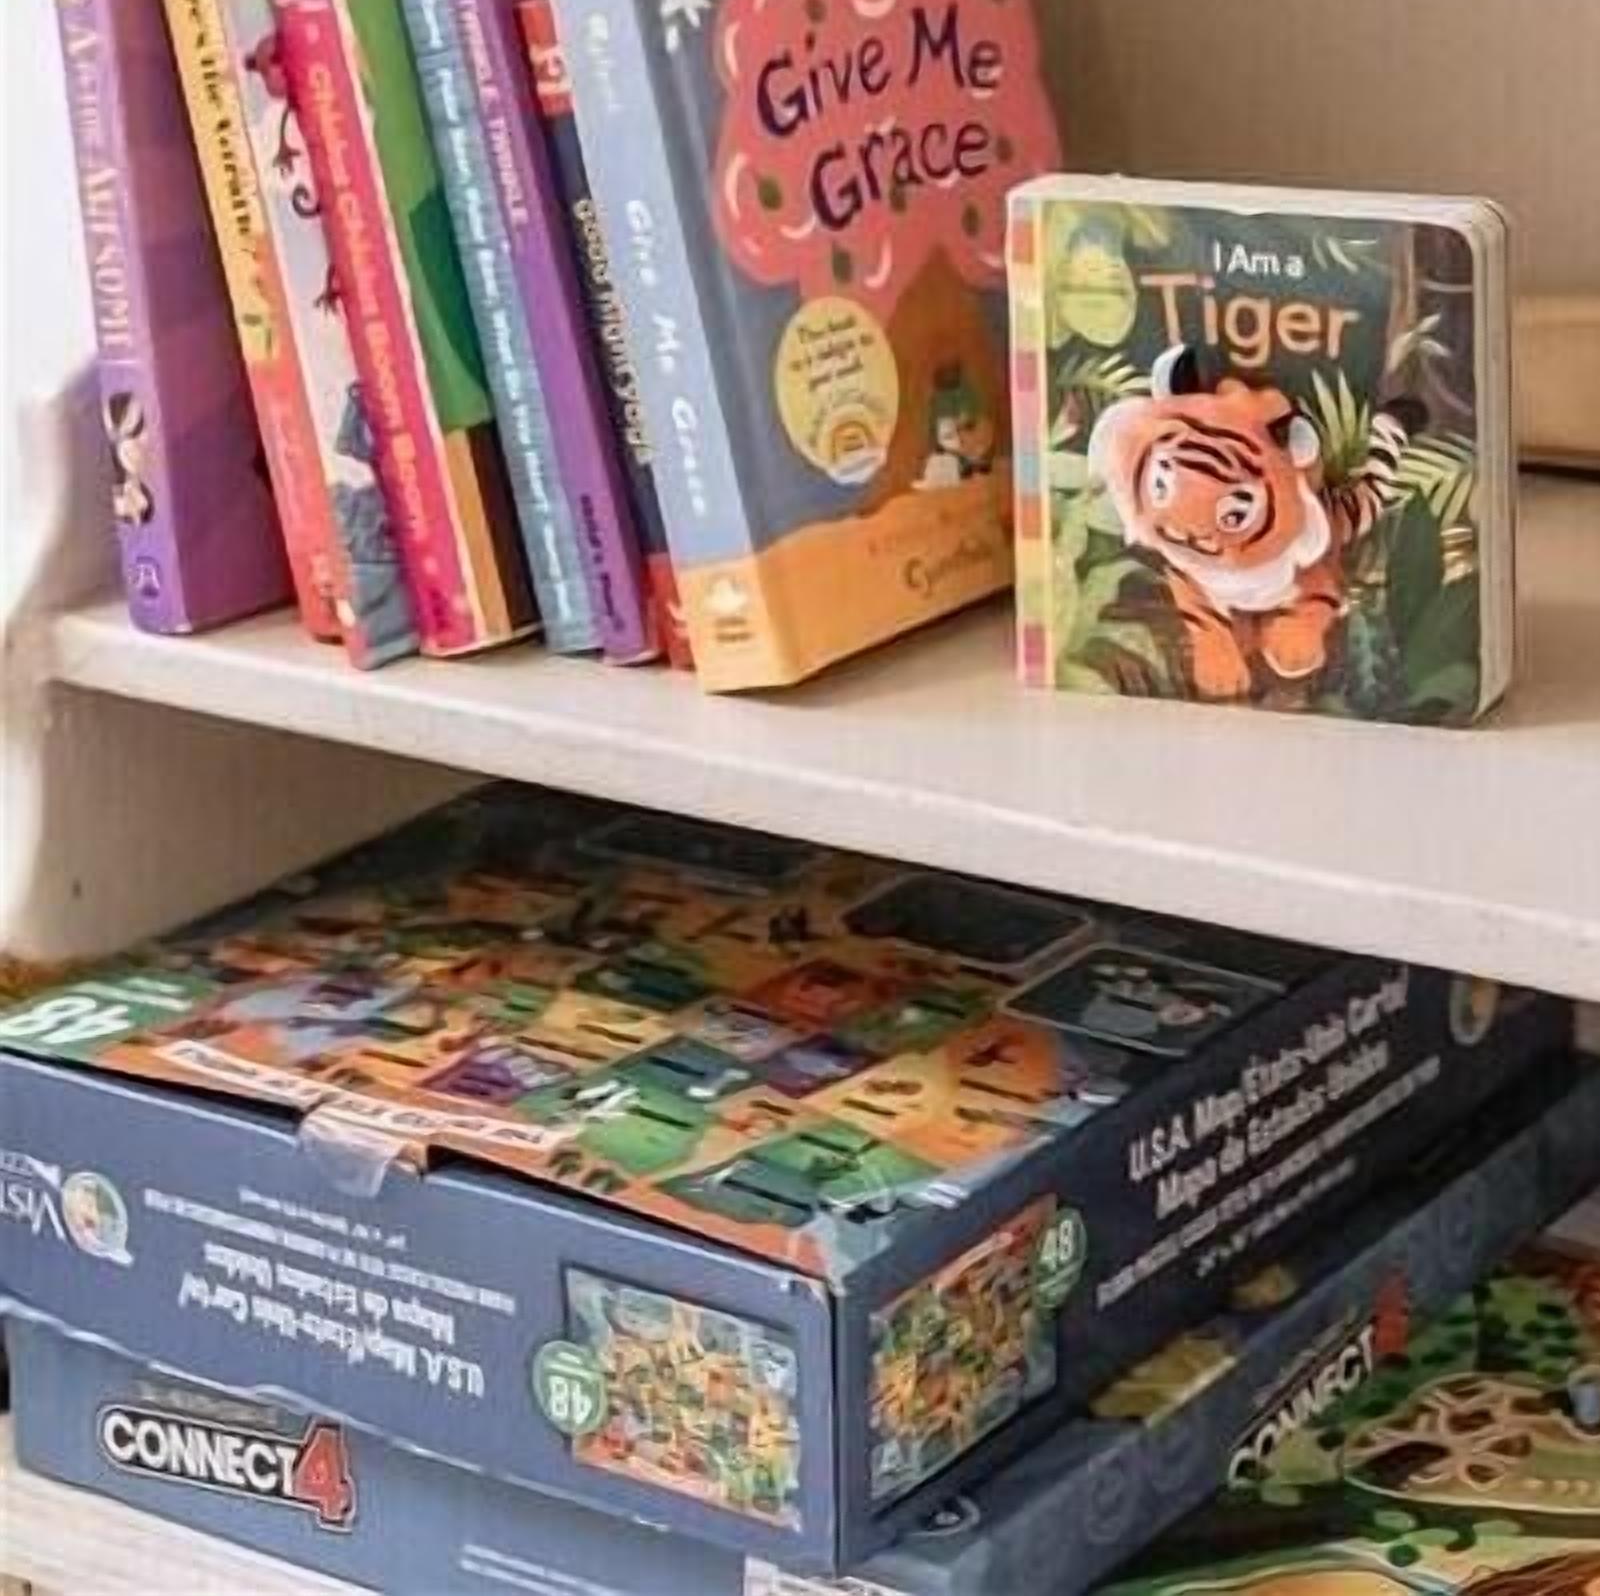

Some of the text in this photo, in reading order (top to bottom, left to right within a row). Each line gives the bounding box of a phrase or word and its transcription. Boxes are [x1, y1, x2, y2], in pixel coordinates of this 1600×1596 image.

[756, 4, 1003, 139] Give Me
[809, 121, 990, 232] Grace
[1212, 240, 1305, 280] I Am a
[1139, 271, 1364, 369] Tiger
[1040, 1217, 1076, 1269] 48
[547, 1372, 593, 1425] 48
[102, 1410, 350, 1522] CONNECT 4
